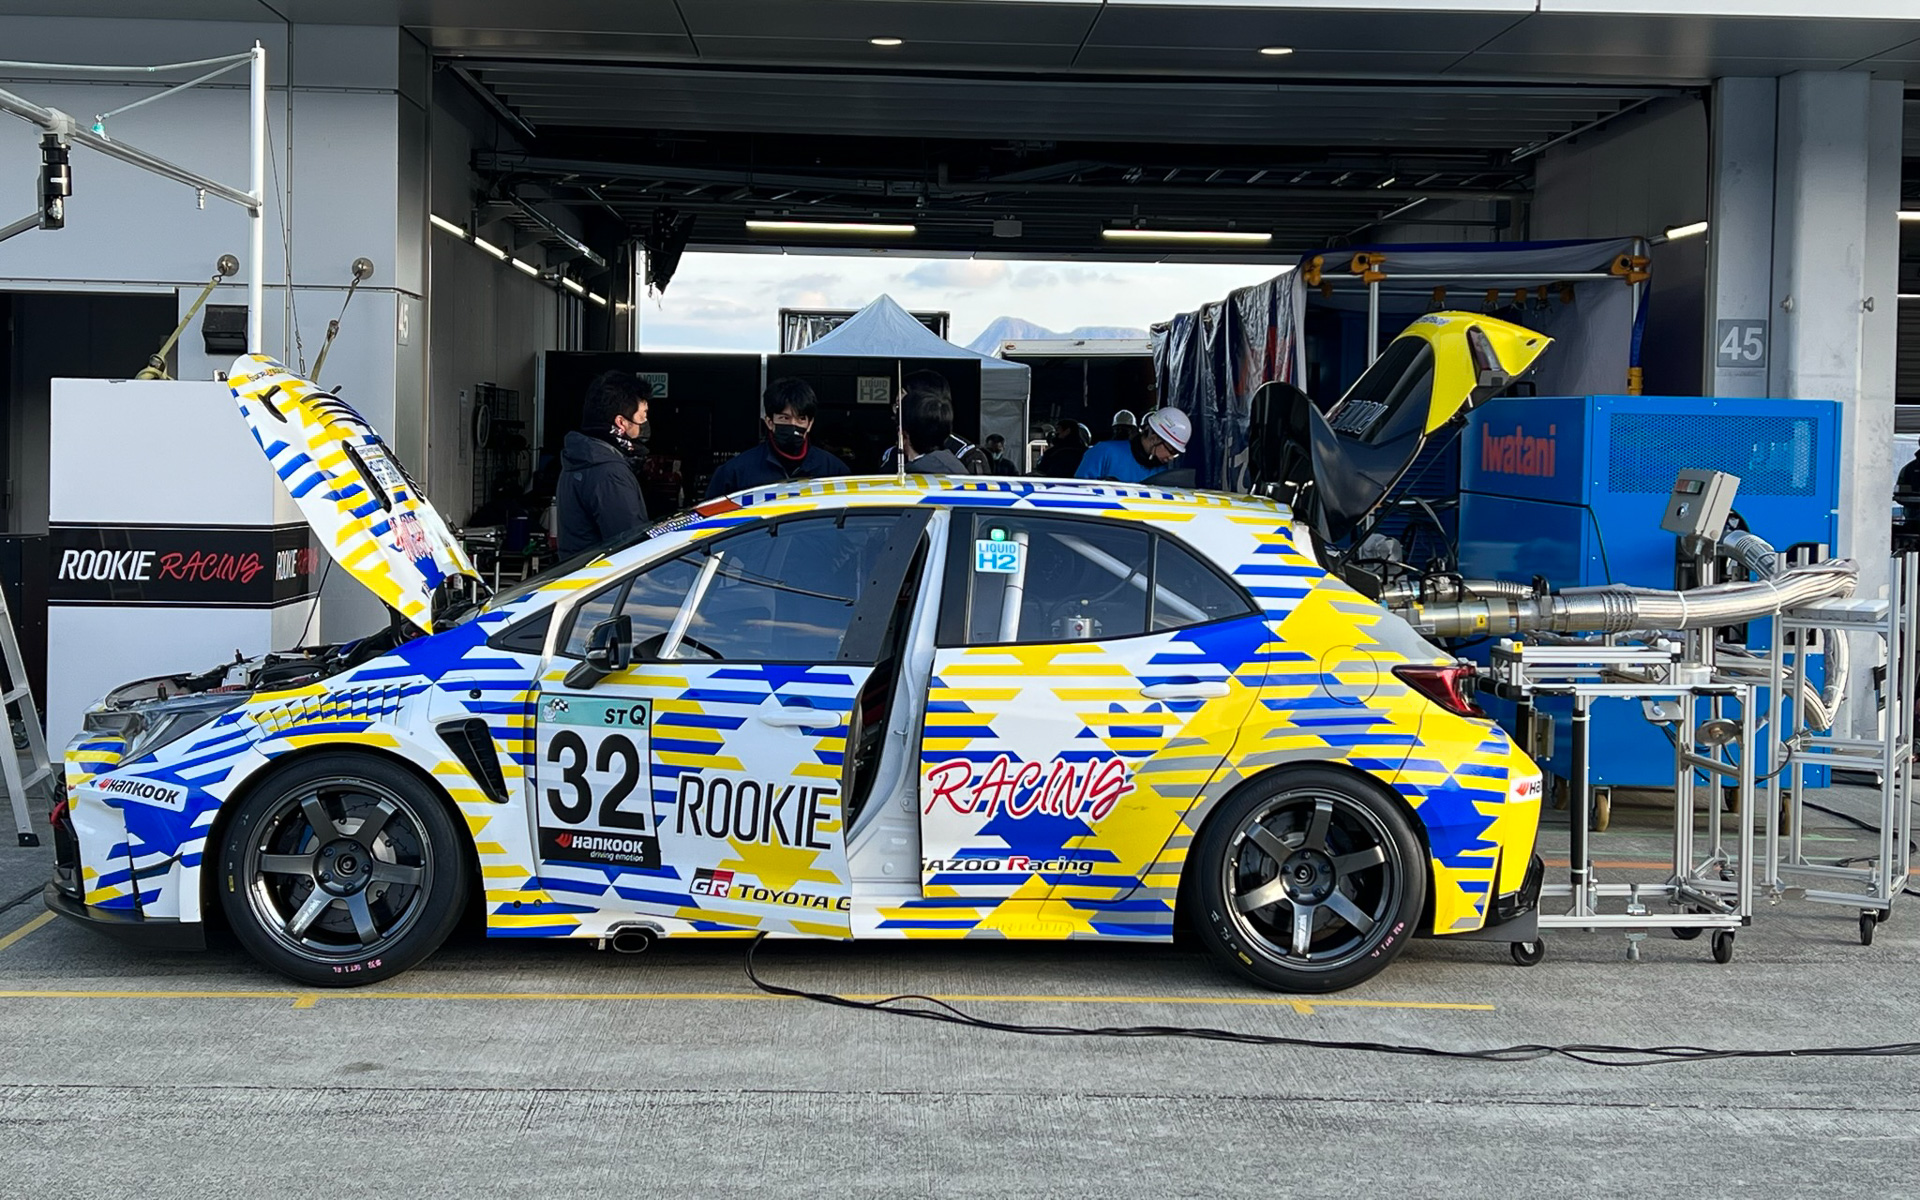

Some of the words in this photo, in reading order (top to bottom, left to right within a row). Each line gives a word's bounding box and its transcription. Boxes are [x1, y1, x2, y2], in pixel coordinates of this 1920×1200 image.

[1720, 326, 1763, 361] 45
[640, 374, 667, 384] IQUID
[859, 380, 889, 388] LIQUID
[859, 388, 888, 401] H2
[1482, 422, 1556, 477] Iwatani
[978, 543, 1017, 554] LIQUID
[978, 553, 1016, 570] H2
[58, 549, 156, 581] ROOKIE
[158, 551, 264, 583] RACING
[546, 730, 646, 831] 32
[924, 757, 1135, 821] RACING
[676, 774, 838, 850] ROOKIE
[590, 850, 614, 861] driving
[615, 853, 644, 862] emotion
[1006, 855, 1095, 876] Racing
[690, 877, 729, 898] GR
[738, 883, 830, 909] TOYOTA
